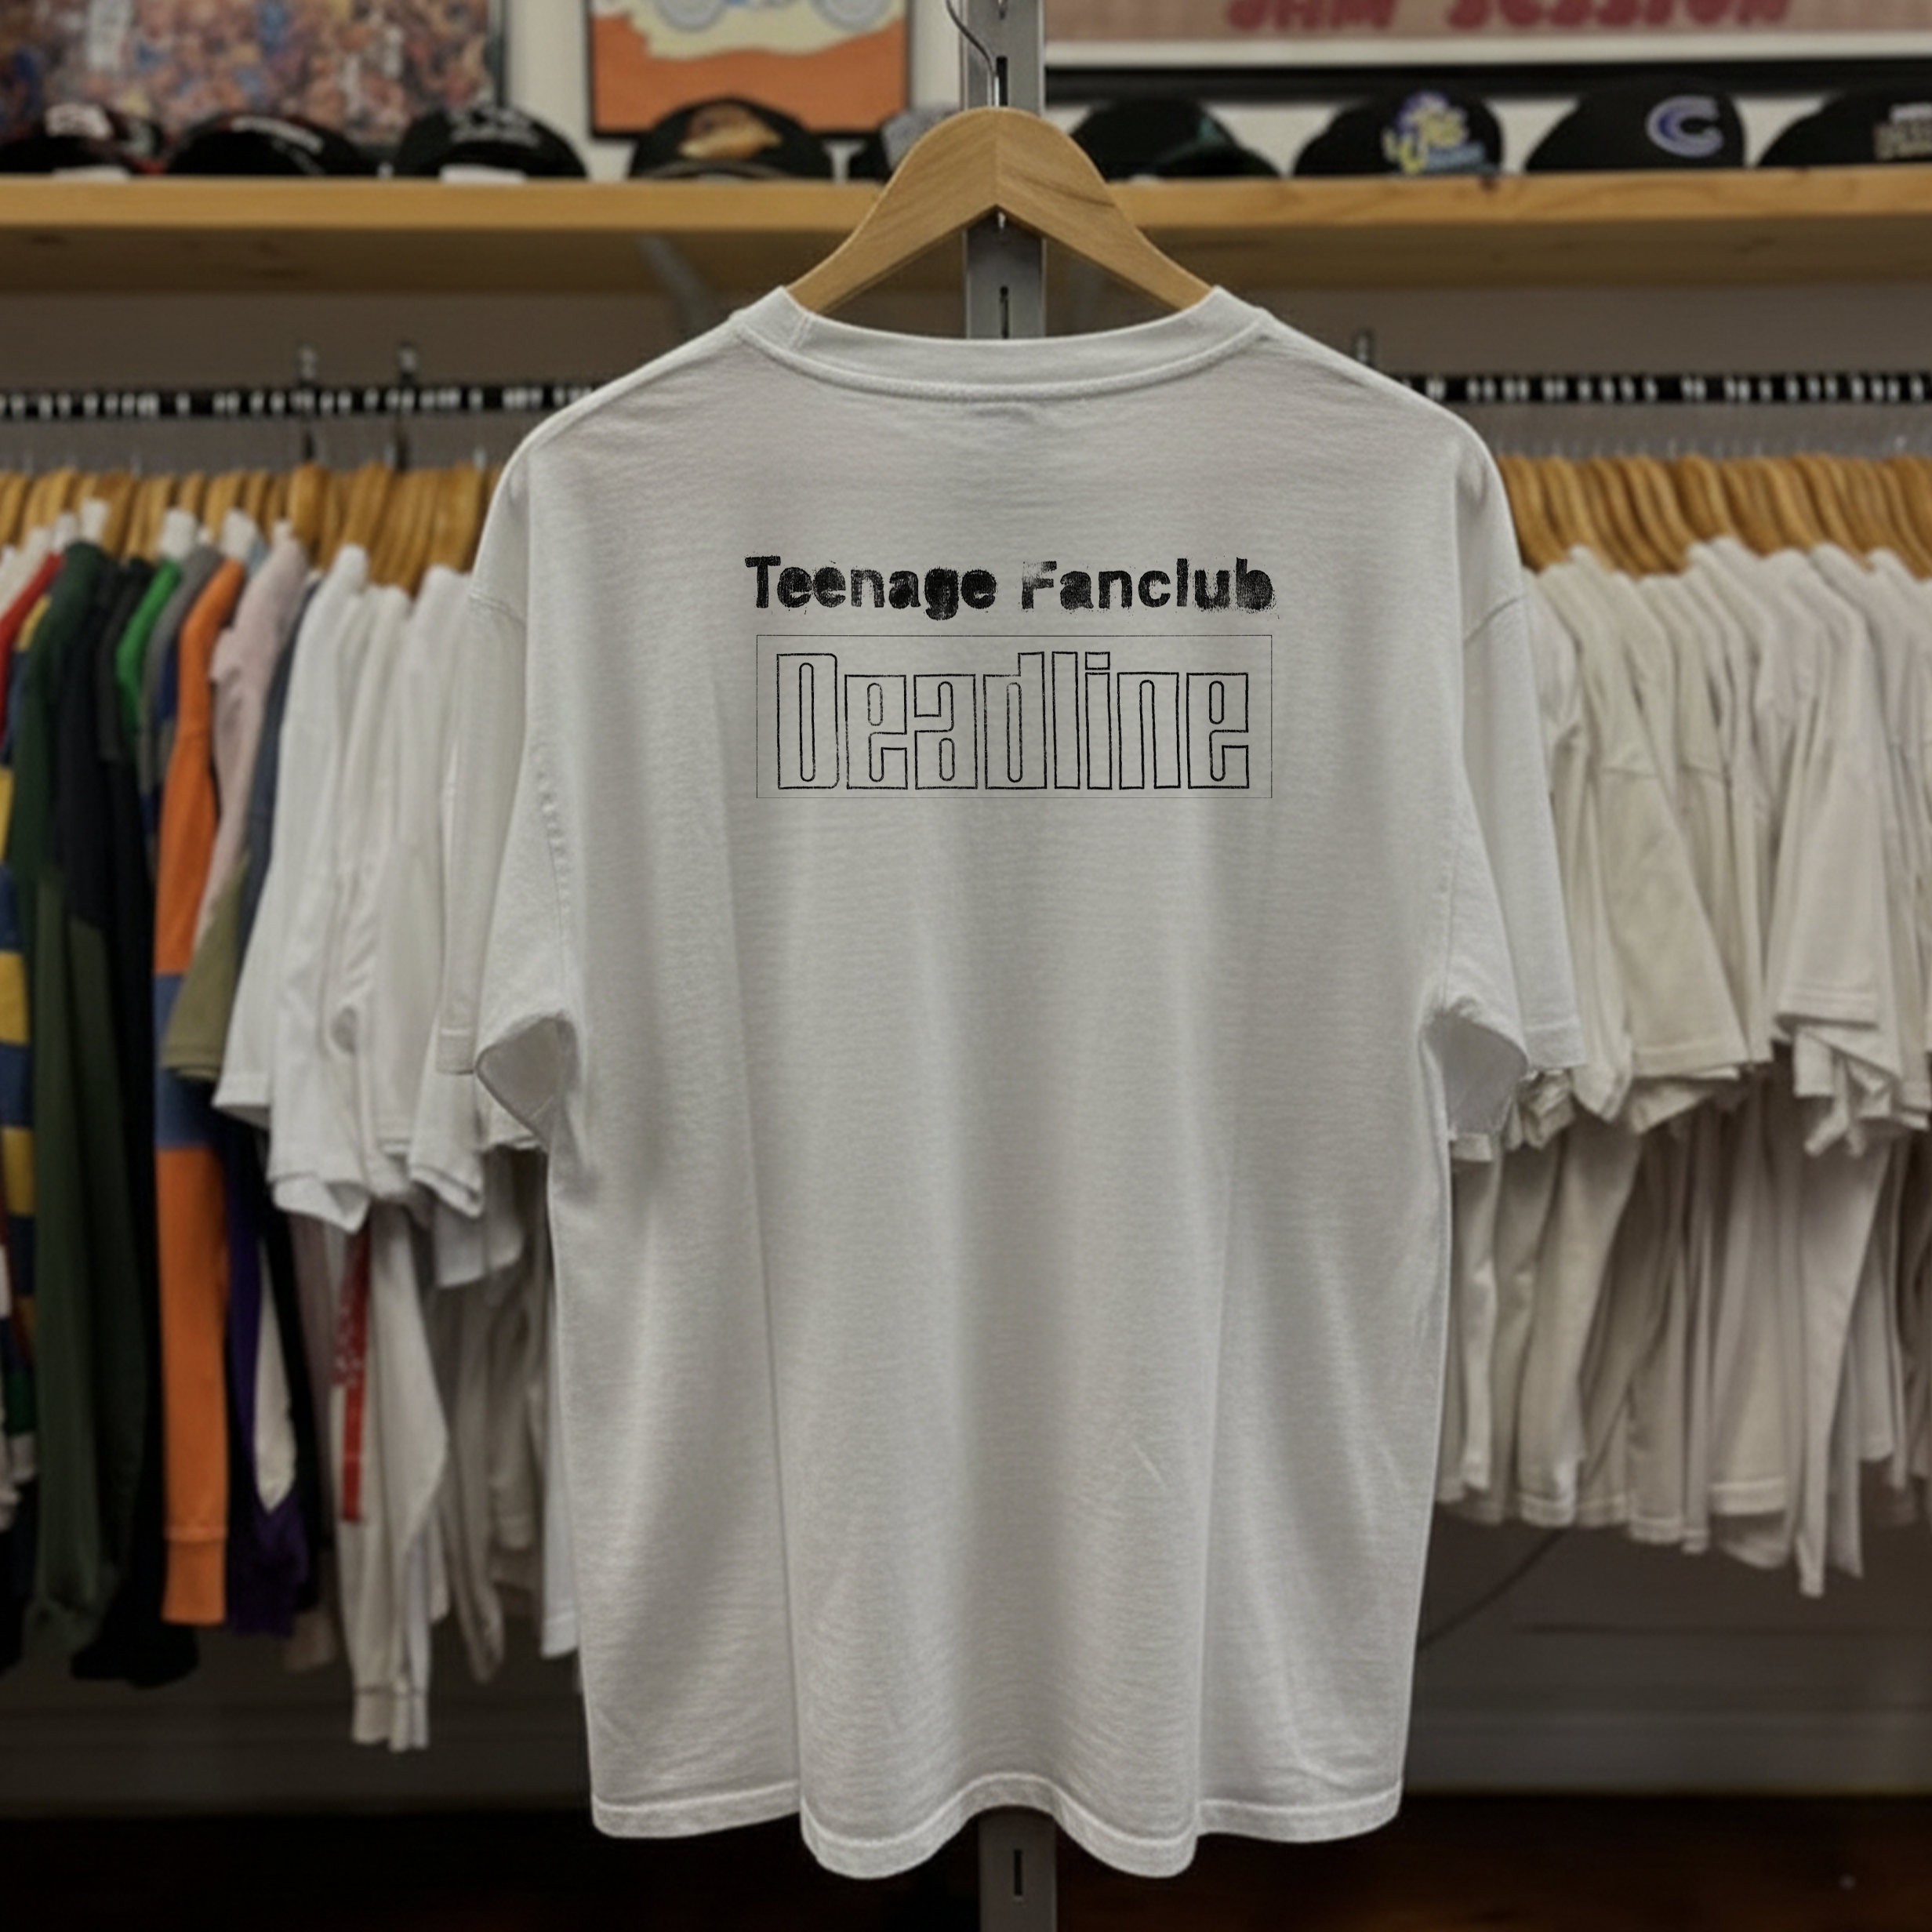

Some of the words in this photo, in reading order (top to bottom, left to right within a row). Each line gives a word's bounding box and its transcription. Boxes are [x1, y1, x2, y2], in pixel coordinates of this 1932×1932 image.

[744, 554, 997, 621] Teenage
[1020, 556, 1275, 612] Fanclub
[775, 650, 1251, 790] Deadline
